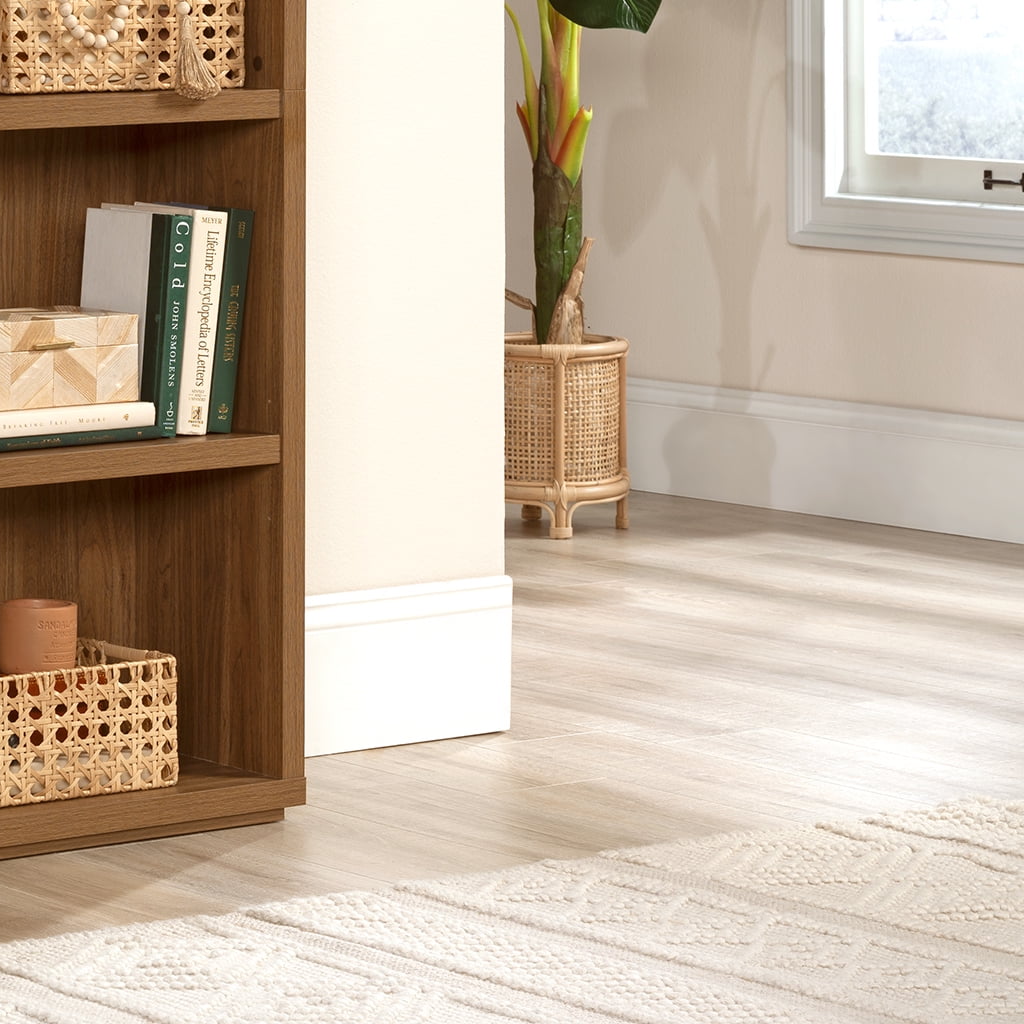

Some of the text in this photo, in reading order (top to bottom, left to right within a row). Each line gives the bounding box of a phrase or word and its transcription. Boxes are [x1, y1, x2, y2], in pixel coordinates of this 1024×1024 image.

[202, 216, 223, 225] MEYER
[205, 230, 220, 272] Lifetime
[167, 221, 190, 387] Cold JOHN SMOLENS
[197, 273, 216, 338] Encyclopedia
[198, 340, 209, 352] of
[195, 354, 209, 387] Letters
